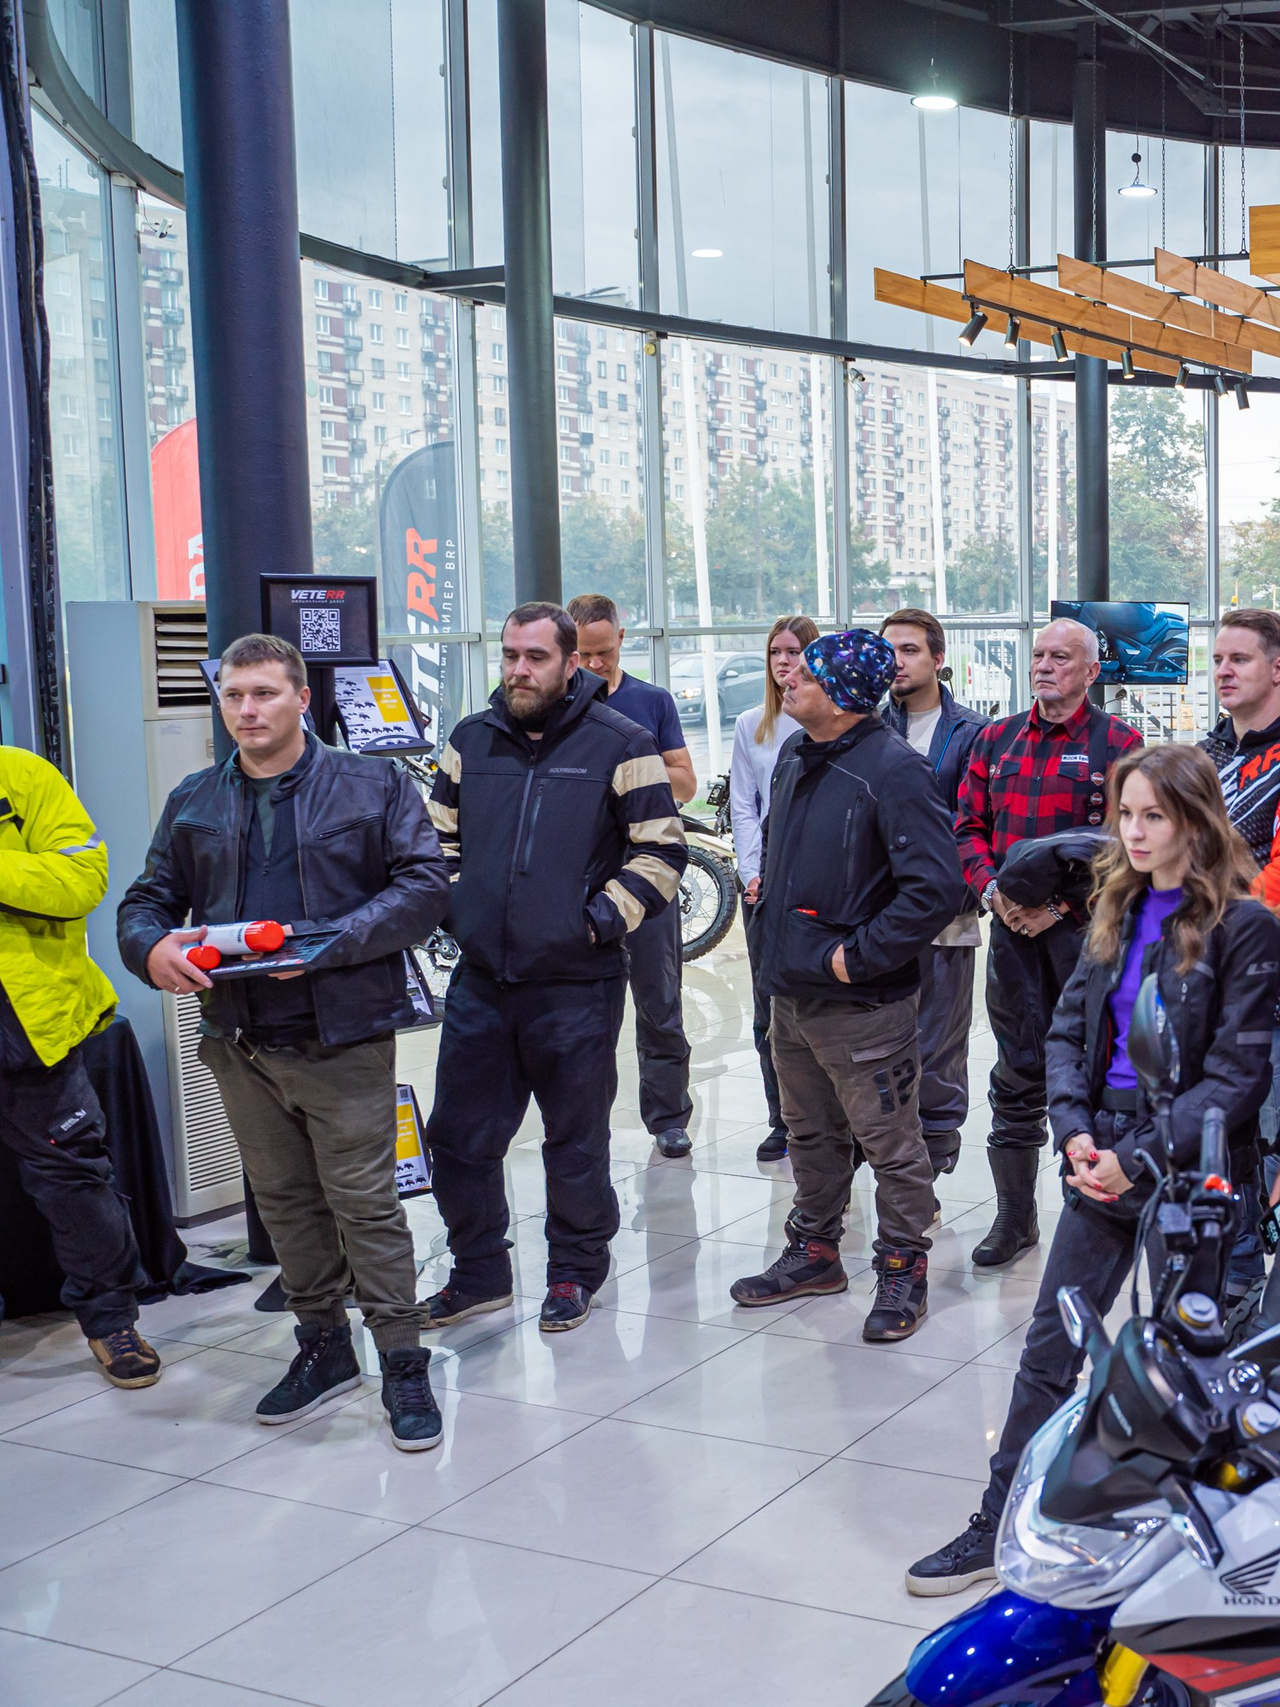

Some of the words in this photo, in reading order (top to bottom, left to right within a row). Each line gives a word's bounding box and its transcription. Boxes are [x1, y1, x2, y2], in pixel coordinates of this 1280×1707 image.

[445, 538, 456, 571] BRP
[291, 589, 346, 600] VETERR
[405, 527, 440, 746] ETERR
